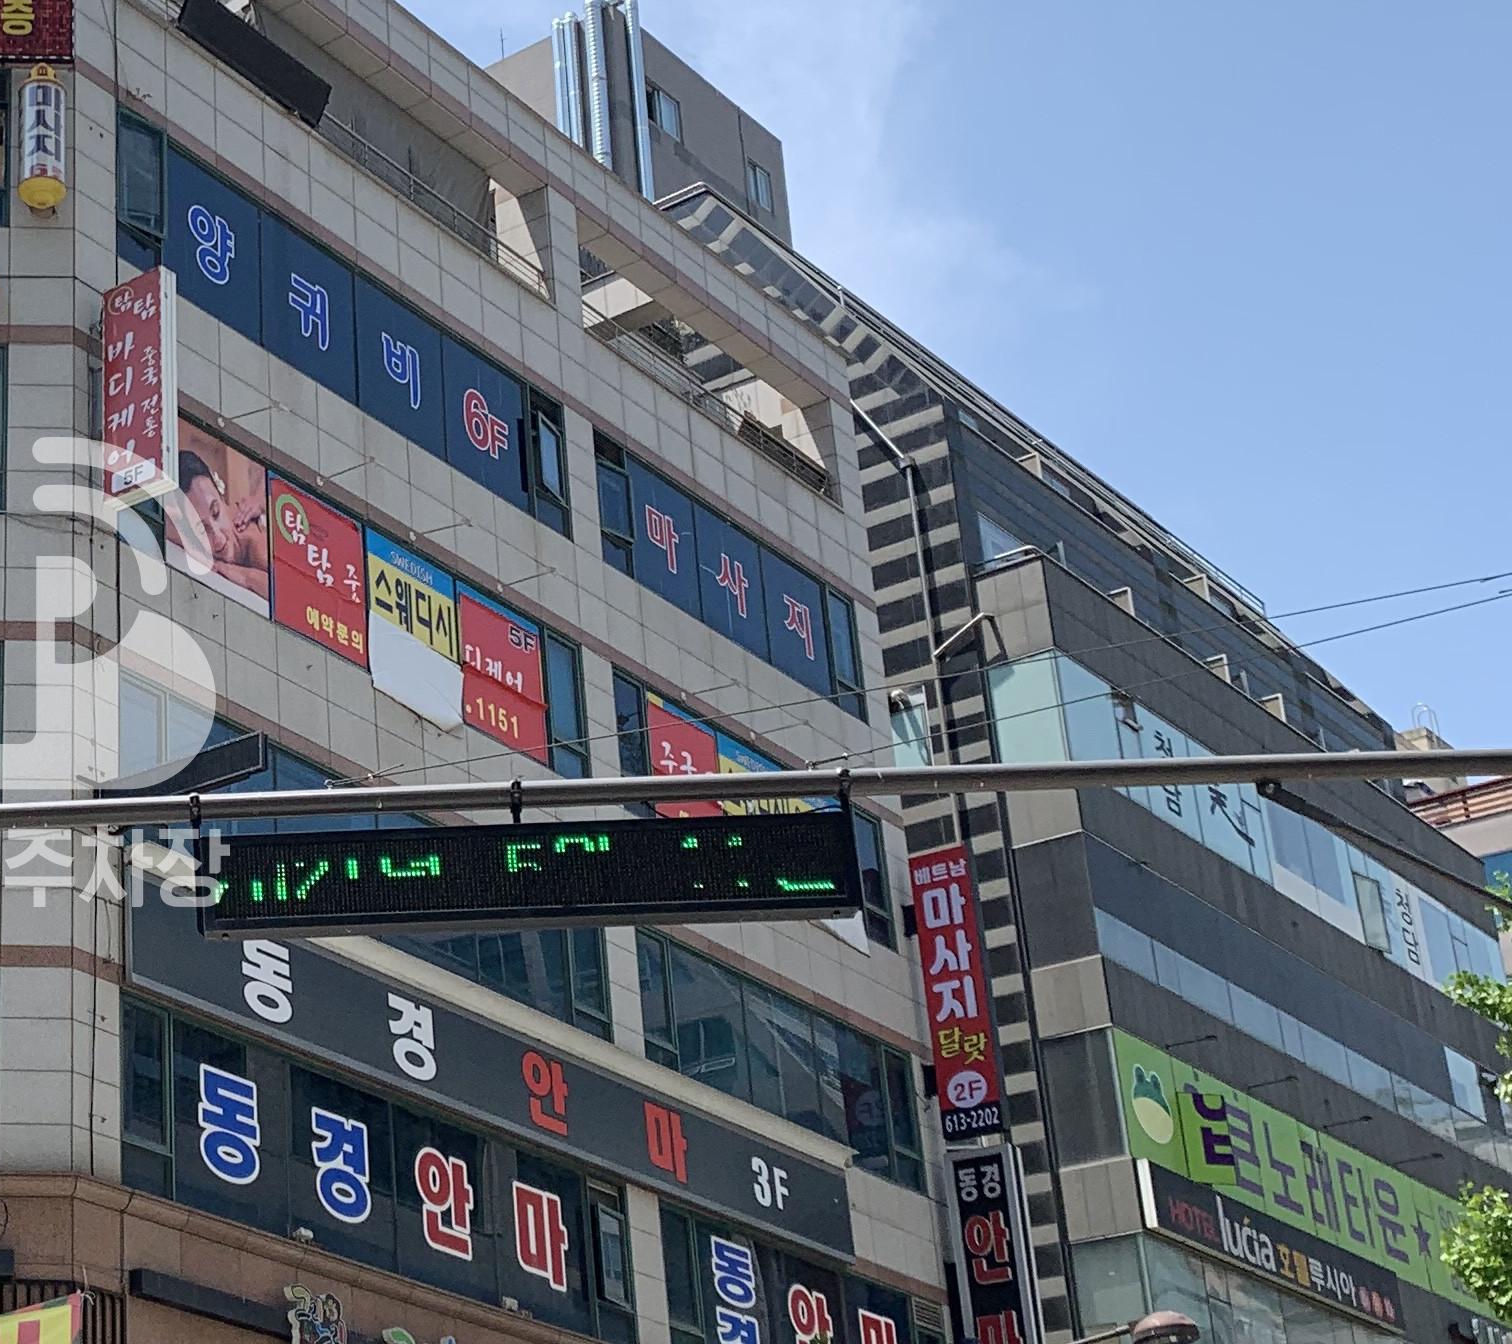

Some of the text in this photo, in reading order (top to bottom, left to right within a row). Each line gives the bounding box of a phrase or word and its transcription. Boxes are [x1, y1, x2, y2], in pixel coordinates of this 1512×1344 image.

[122, 463, 145, 486] 5F
[461, 388, 511, 461] 6F
[644, 504, 817, 660] 마사지
[388, 550, 434, 586] SWEDISH
[304, 604, 365, 655] 예약문의
[373, 567, 457, 657] 스웨디시
[507, 624, 537, 654] 5F
[913, 858, 966, 886] 베트남
[921, 882, 979, 1024] 마사지
[952, 1077, 983, 1102] 2F
[521, 1049, 689, 1185] 안마
[749, 1155, 791, 1212] 3F
[944, 1106, 1001, 1134] 613-2202
[197, 1062, 568, 1294] 동경 안마
